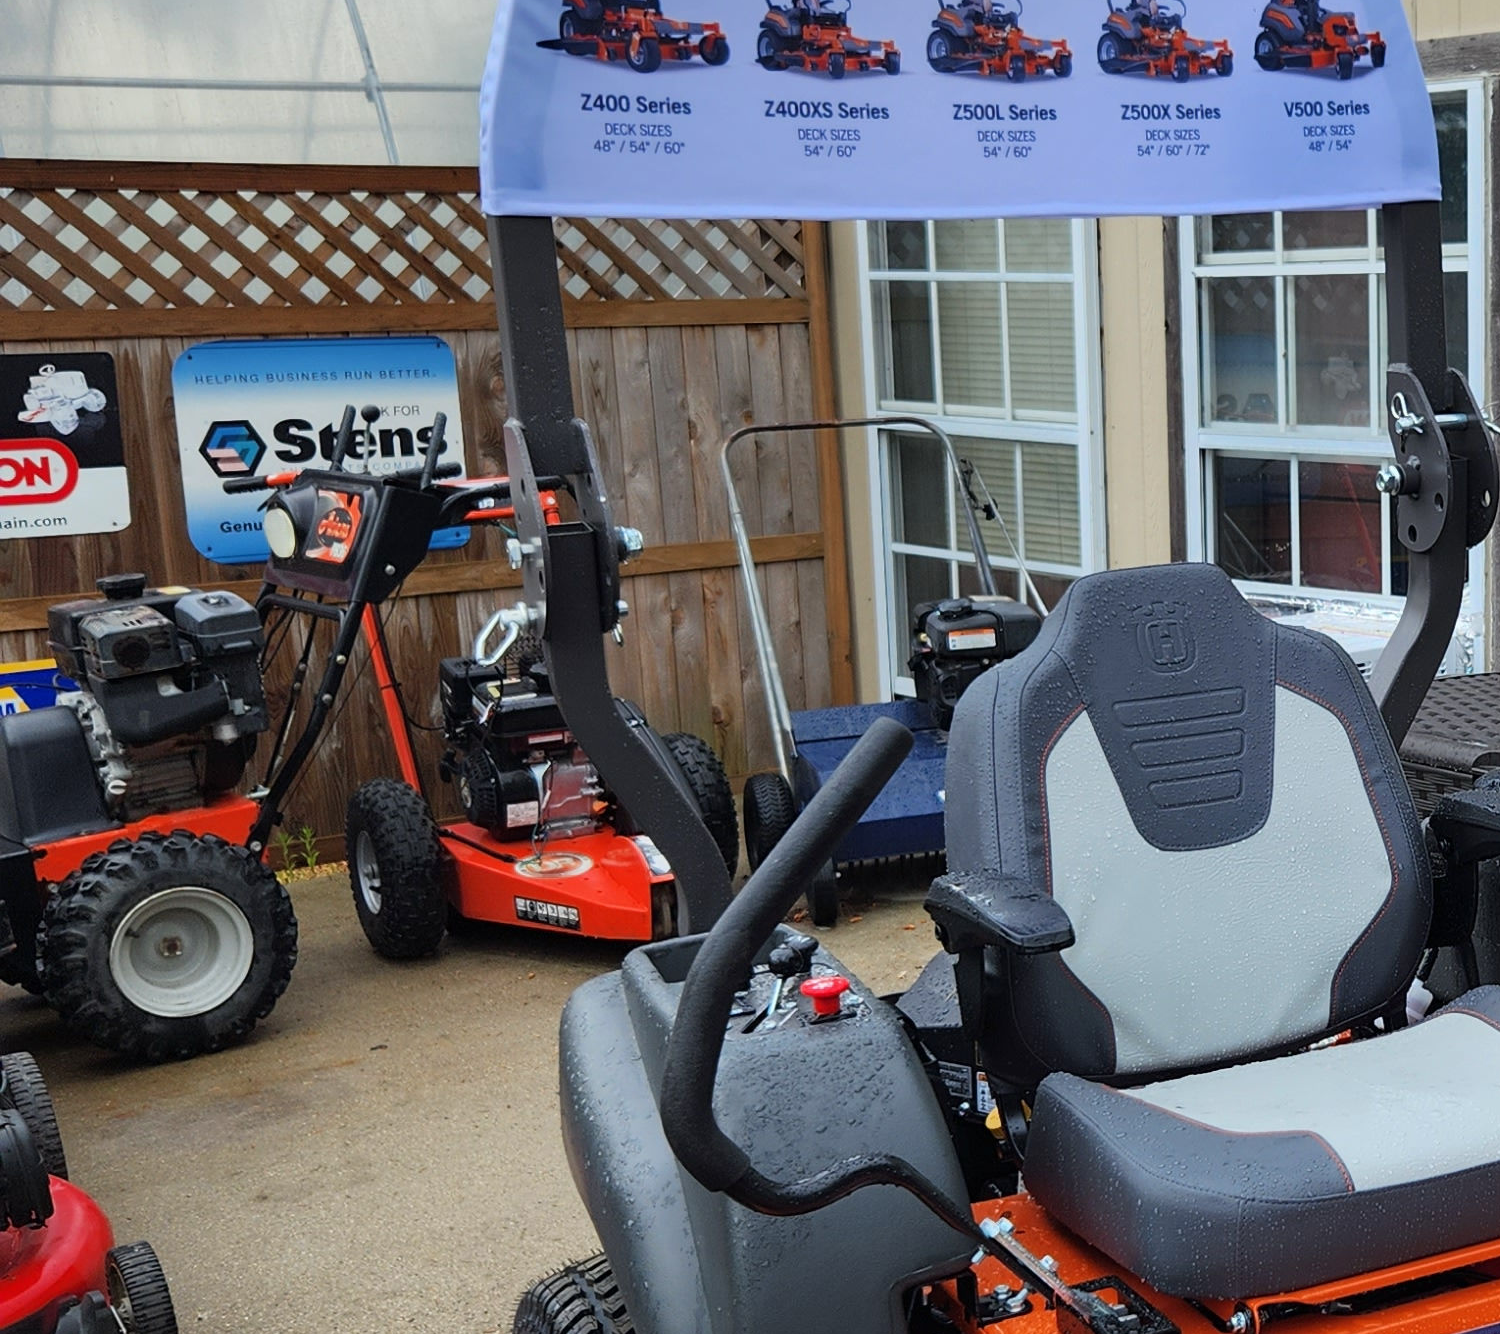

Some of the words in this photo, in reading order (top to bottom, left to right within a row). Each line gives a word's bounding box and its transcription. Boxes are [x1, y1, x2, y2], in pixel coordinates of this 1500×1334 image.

[580, 93, 631, 113] Z400
[636, 95, 692, 115] Series
[763, 99, 834, 119] Z400XS
[837, 101, 890, 120] Series
[1283, 101, 1323, 119] V500
[1326, 99, 1371, 117] Series
[952, 103, 1005, 121] Z500L
[1008, 103, 1058, 122] Series
[1120, 103, 1172, 121] Z500X
[1175, 103, 1222, 121] Series
[604, 122, 637, 138] DECK
[639, 123, 673, 138] SIZES
[797, 127, 829, 142] DECK
[830, 128, 861, 142] SIZES
[977, 129, 1005, 143] DECK
[1007, 129, 1037, 143] SIZES
[1144, 128, 1172, 142] DECK
[1173, 128, 1201, 142] SIZES
[1302, 125, 1328, 139] DECK
[1329, 124, 1356, 137] SIZES
[593, 139, 616, 154] 48"
[629, 140, 651, 154] 54"
[664, 141, 686, 154] 60"
[804, 144, 825, 158] 54"
[836, 145, 857, 158] 60"
[982, 145, 1002, 158] 54"
[1013, 145, 1033, 158] 60"
[1136, 144, 1156, 157] 54"
[1165, 144, 1184, 157] 60"
[1193, 144, 1211, 156] 72"
[1308, 140, 1326, 152] 48"
[1335, 139, 1353, 152] 54"
[194, 373, 260, 386] HELPING
[266, 370, 339, 384] BUSINESS
[344, 369, 374, 381] RUN
[393, 404, 421, 417] FOR
[272, 417, 448, 464] Stens
[0, 516, 68, 531] ain.com
